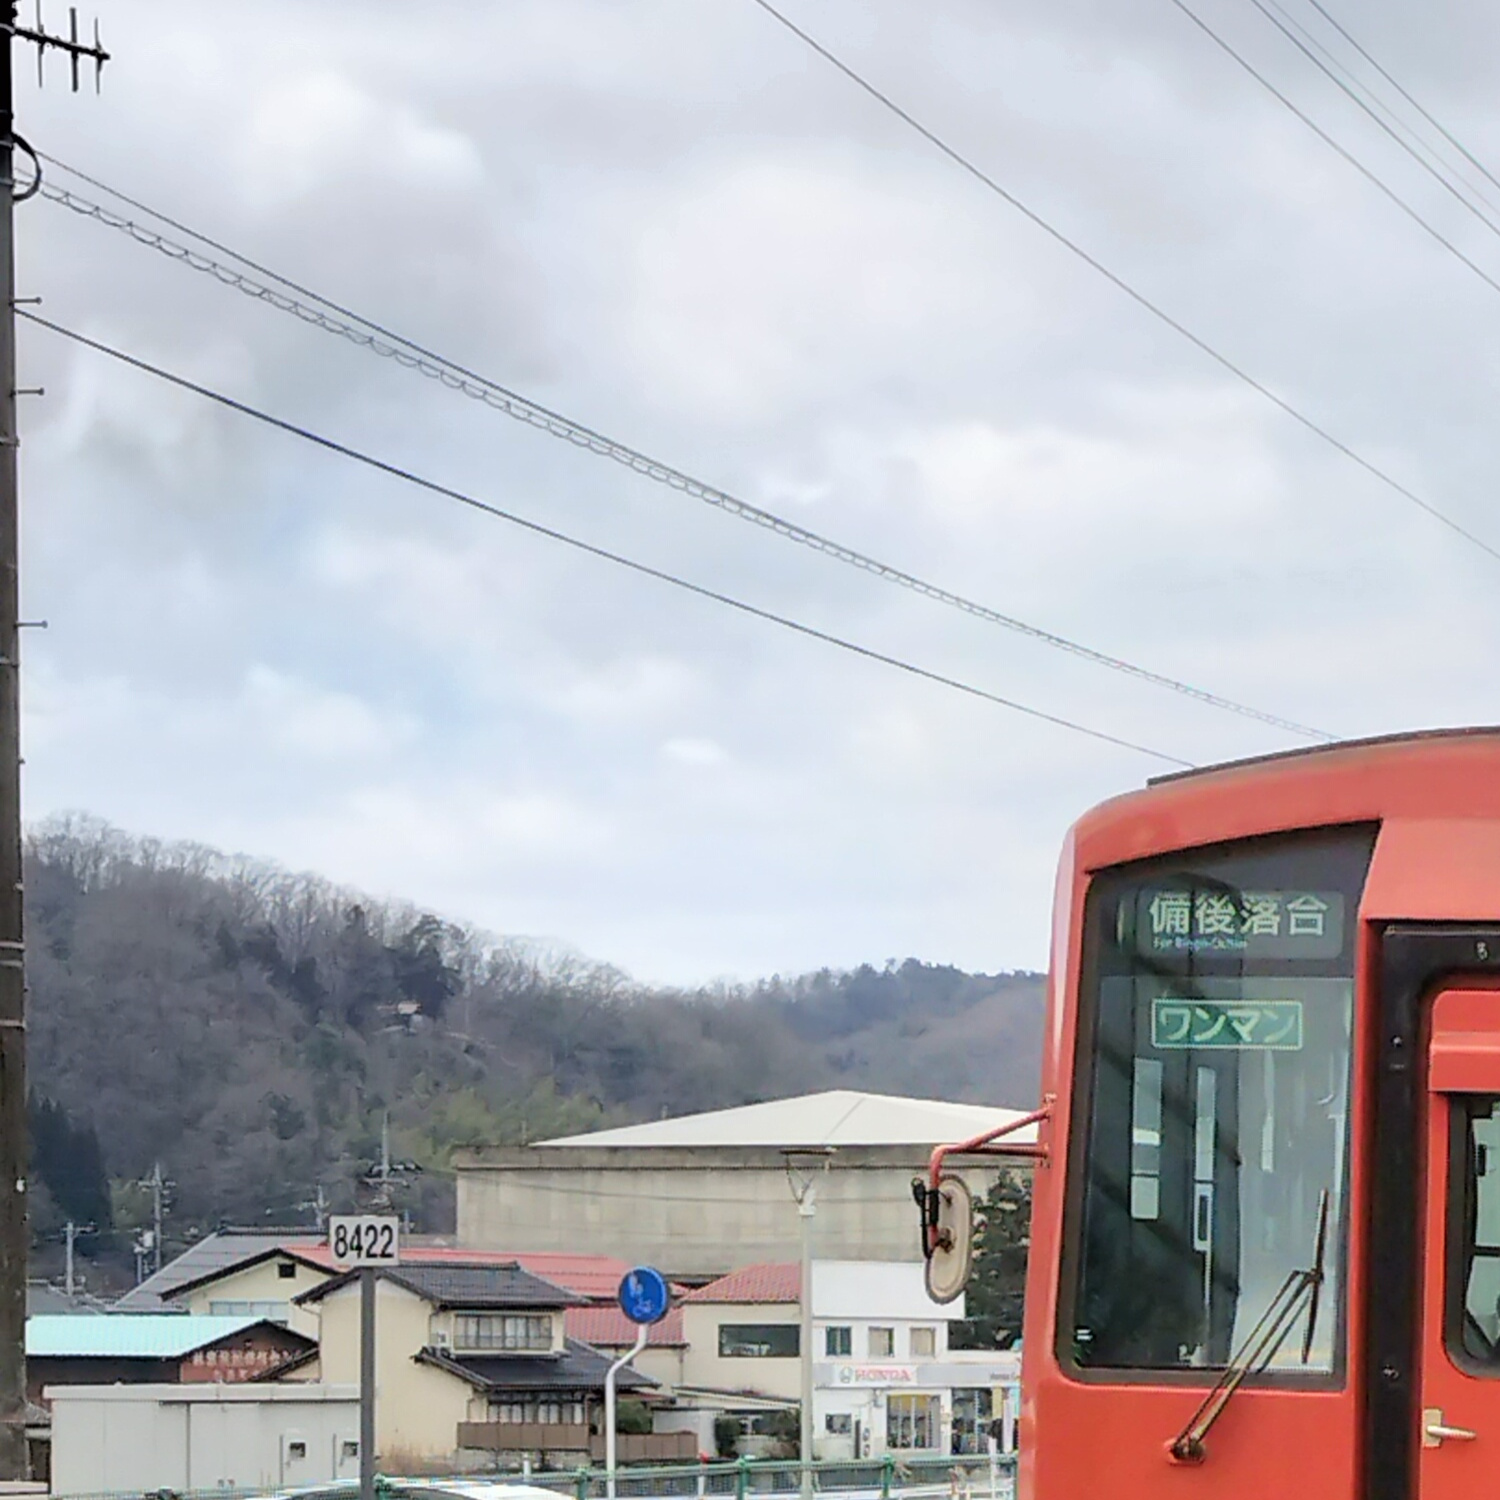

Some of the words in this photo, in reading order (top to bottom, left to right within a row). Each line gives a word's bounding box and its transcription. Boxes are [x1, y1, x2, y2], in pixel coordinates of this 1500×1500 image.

[1149, 893, 1328, 936] 備後落合
[1160, 1007, 1295, 1043] ワンマン
[334, 1224, 394, 1259] 8422
[855, 1369, 910, 1383] HONDA
